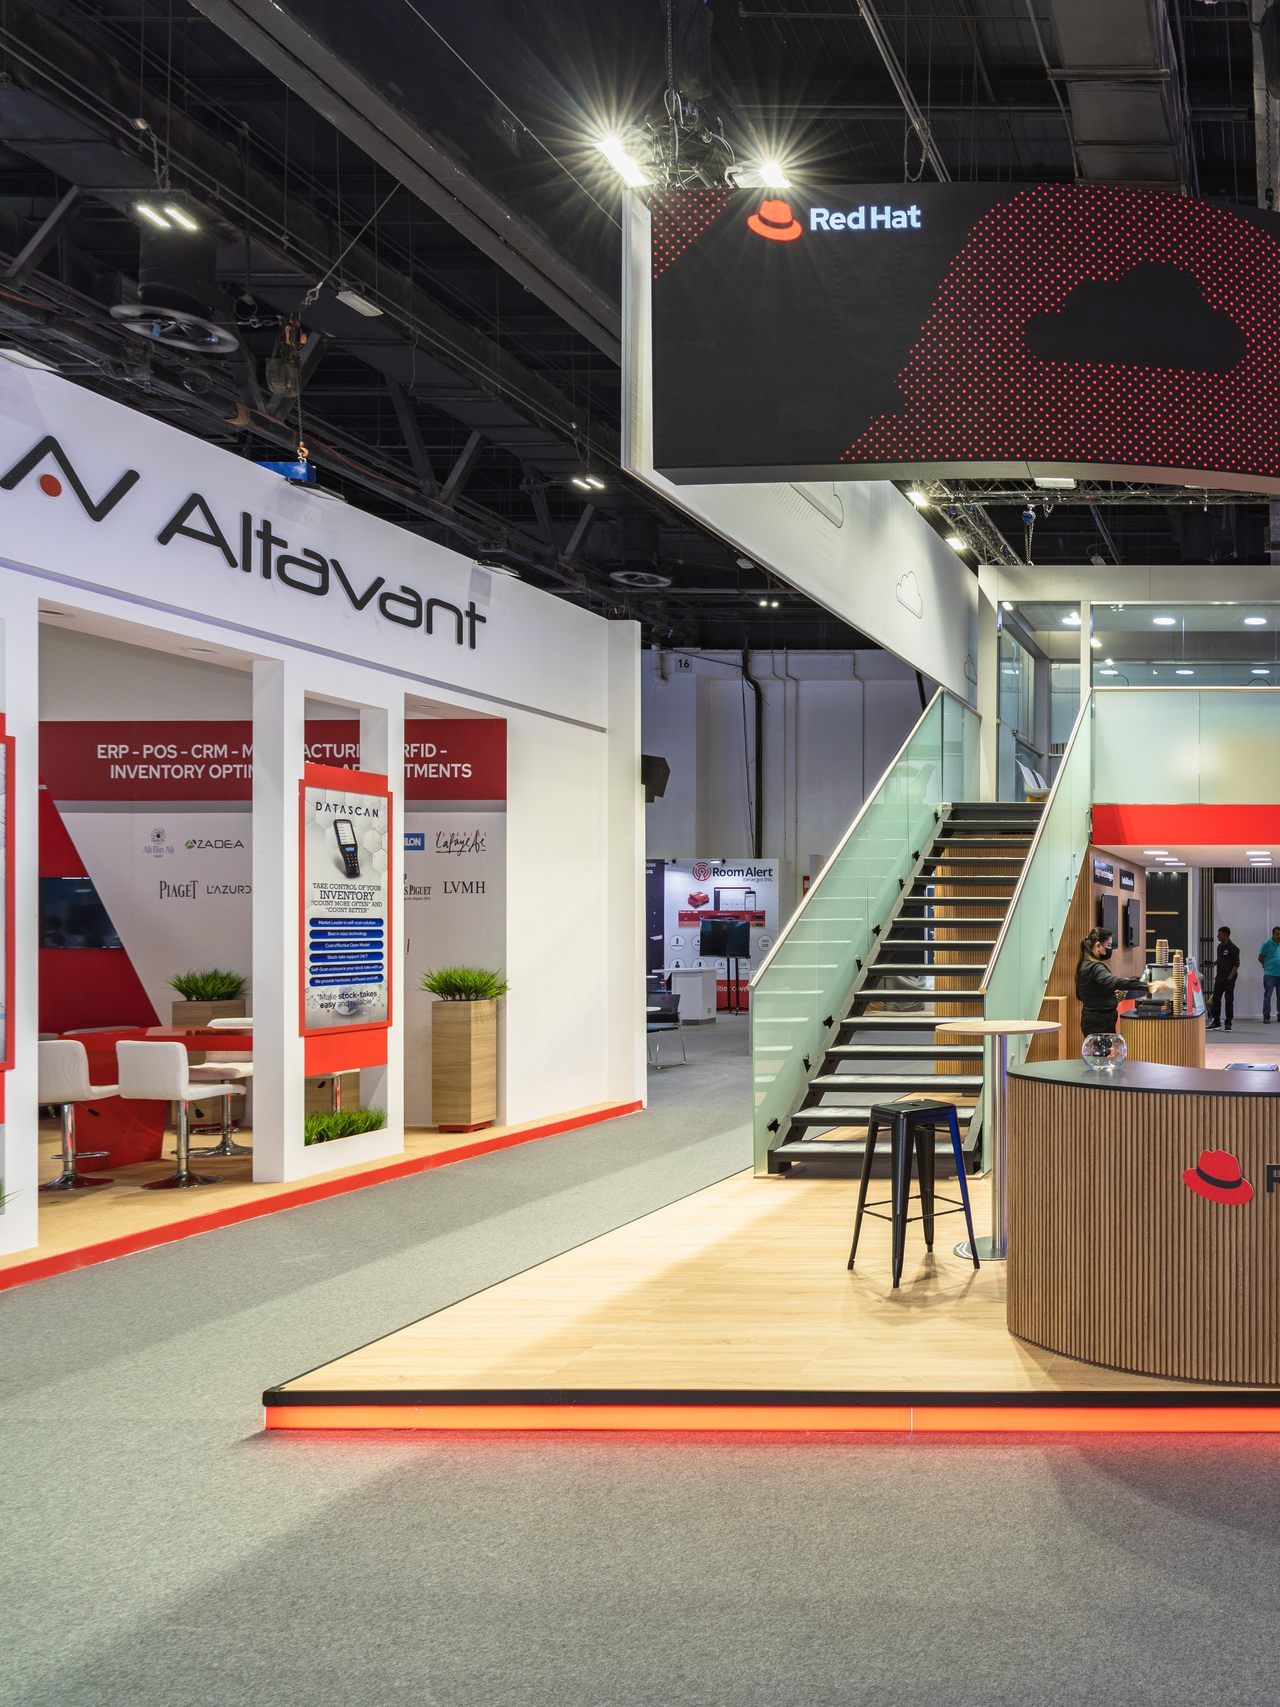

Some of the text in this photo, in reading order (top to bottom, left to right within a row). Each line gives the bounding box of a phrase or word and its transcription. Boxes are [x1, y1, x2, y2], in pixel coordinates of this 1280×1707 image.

[810, 204, 922, 231] Red Hat
[156, 493, 487, 651] Altavant
[678, 658, 690, 668] 16
[97, 744, 129, 759] ERP
[143, 744, 177, 759] POS
[191, 744, 228, 759] CRM
[110, 764, 205, 779] INVENTORY
[315, 801, 380, 818] DATASCAN
[712, 866, 773, 877] Room Alert
[159, 880, 199, 899] PIAGET
[443, 880, 486, 894] LVMH
[320, 890, 374, 900] INVENTORY
[338, 991, 378, 1000] stock-takes
